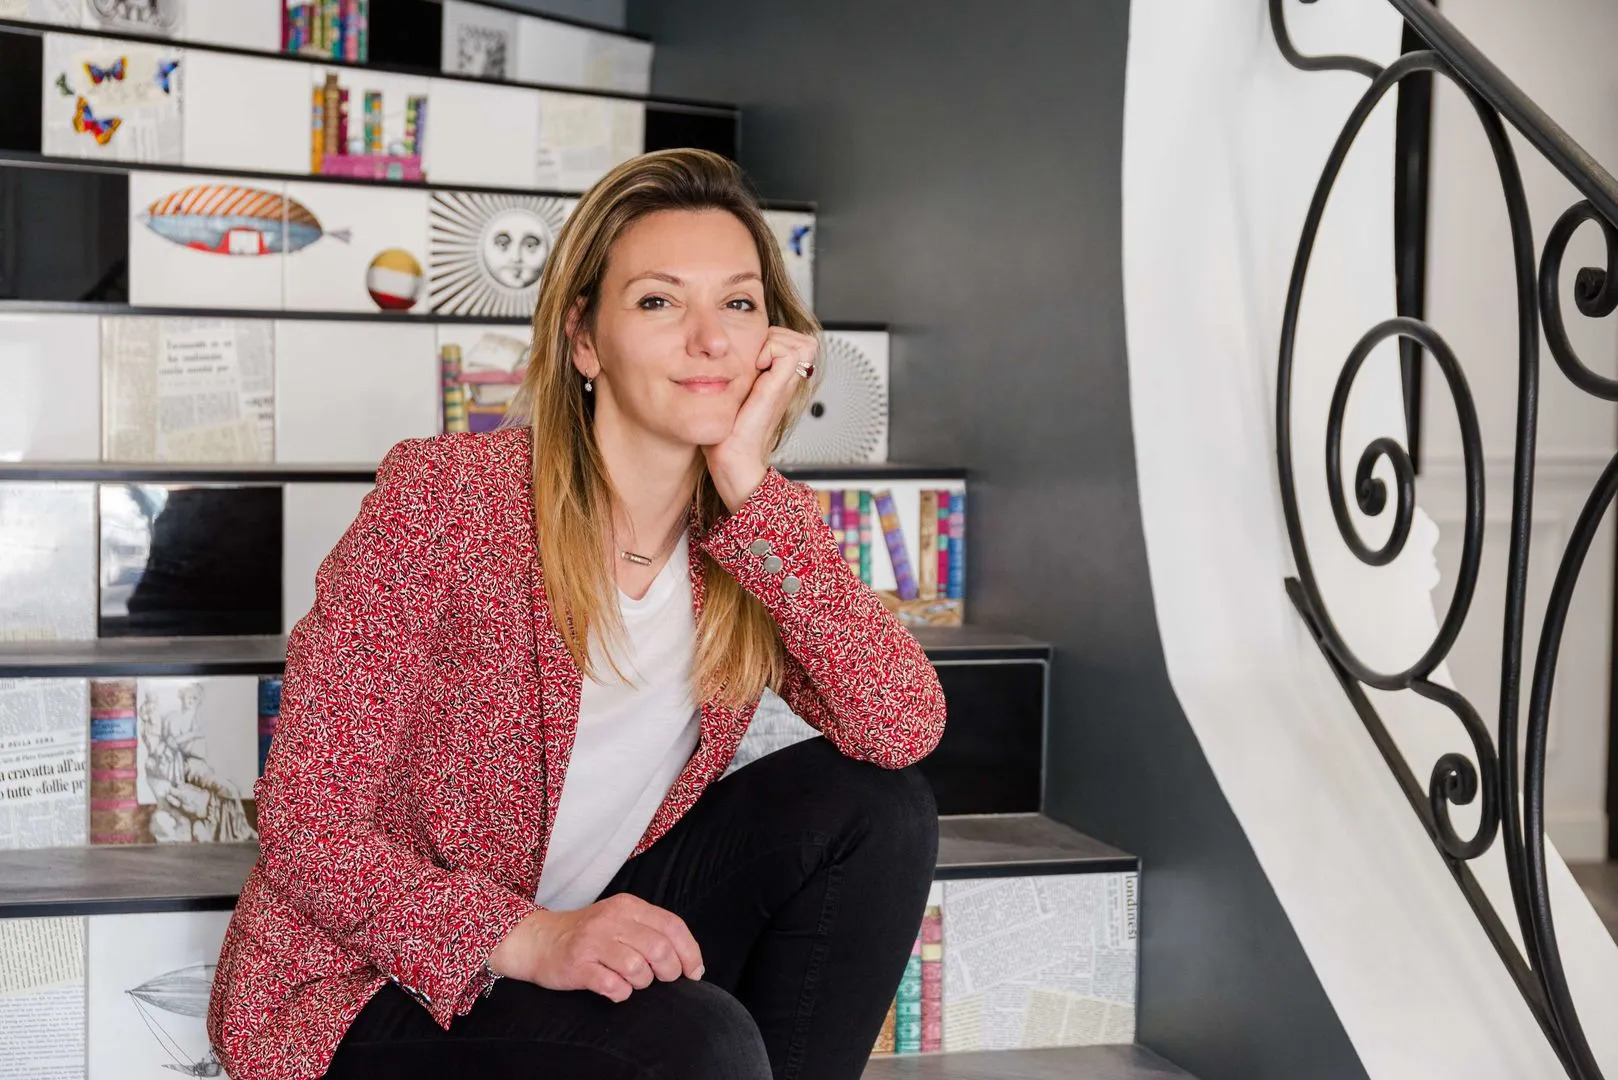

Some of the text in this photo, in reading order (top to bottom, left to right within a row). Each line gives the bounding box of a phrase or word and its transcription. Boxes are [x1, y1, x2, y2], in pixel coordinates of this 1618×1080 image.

[8, 764, 54, 780] cravatta
[7, 785, 33, 799] tutte
[1126, 874, 1138, 940] londinesi
